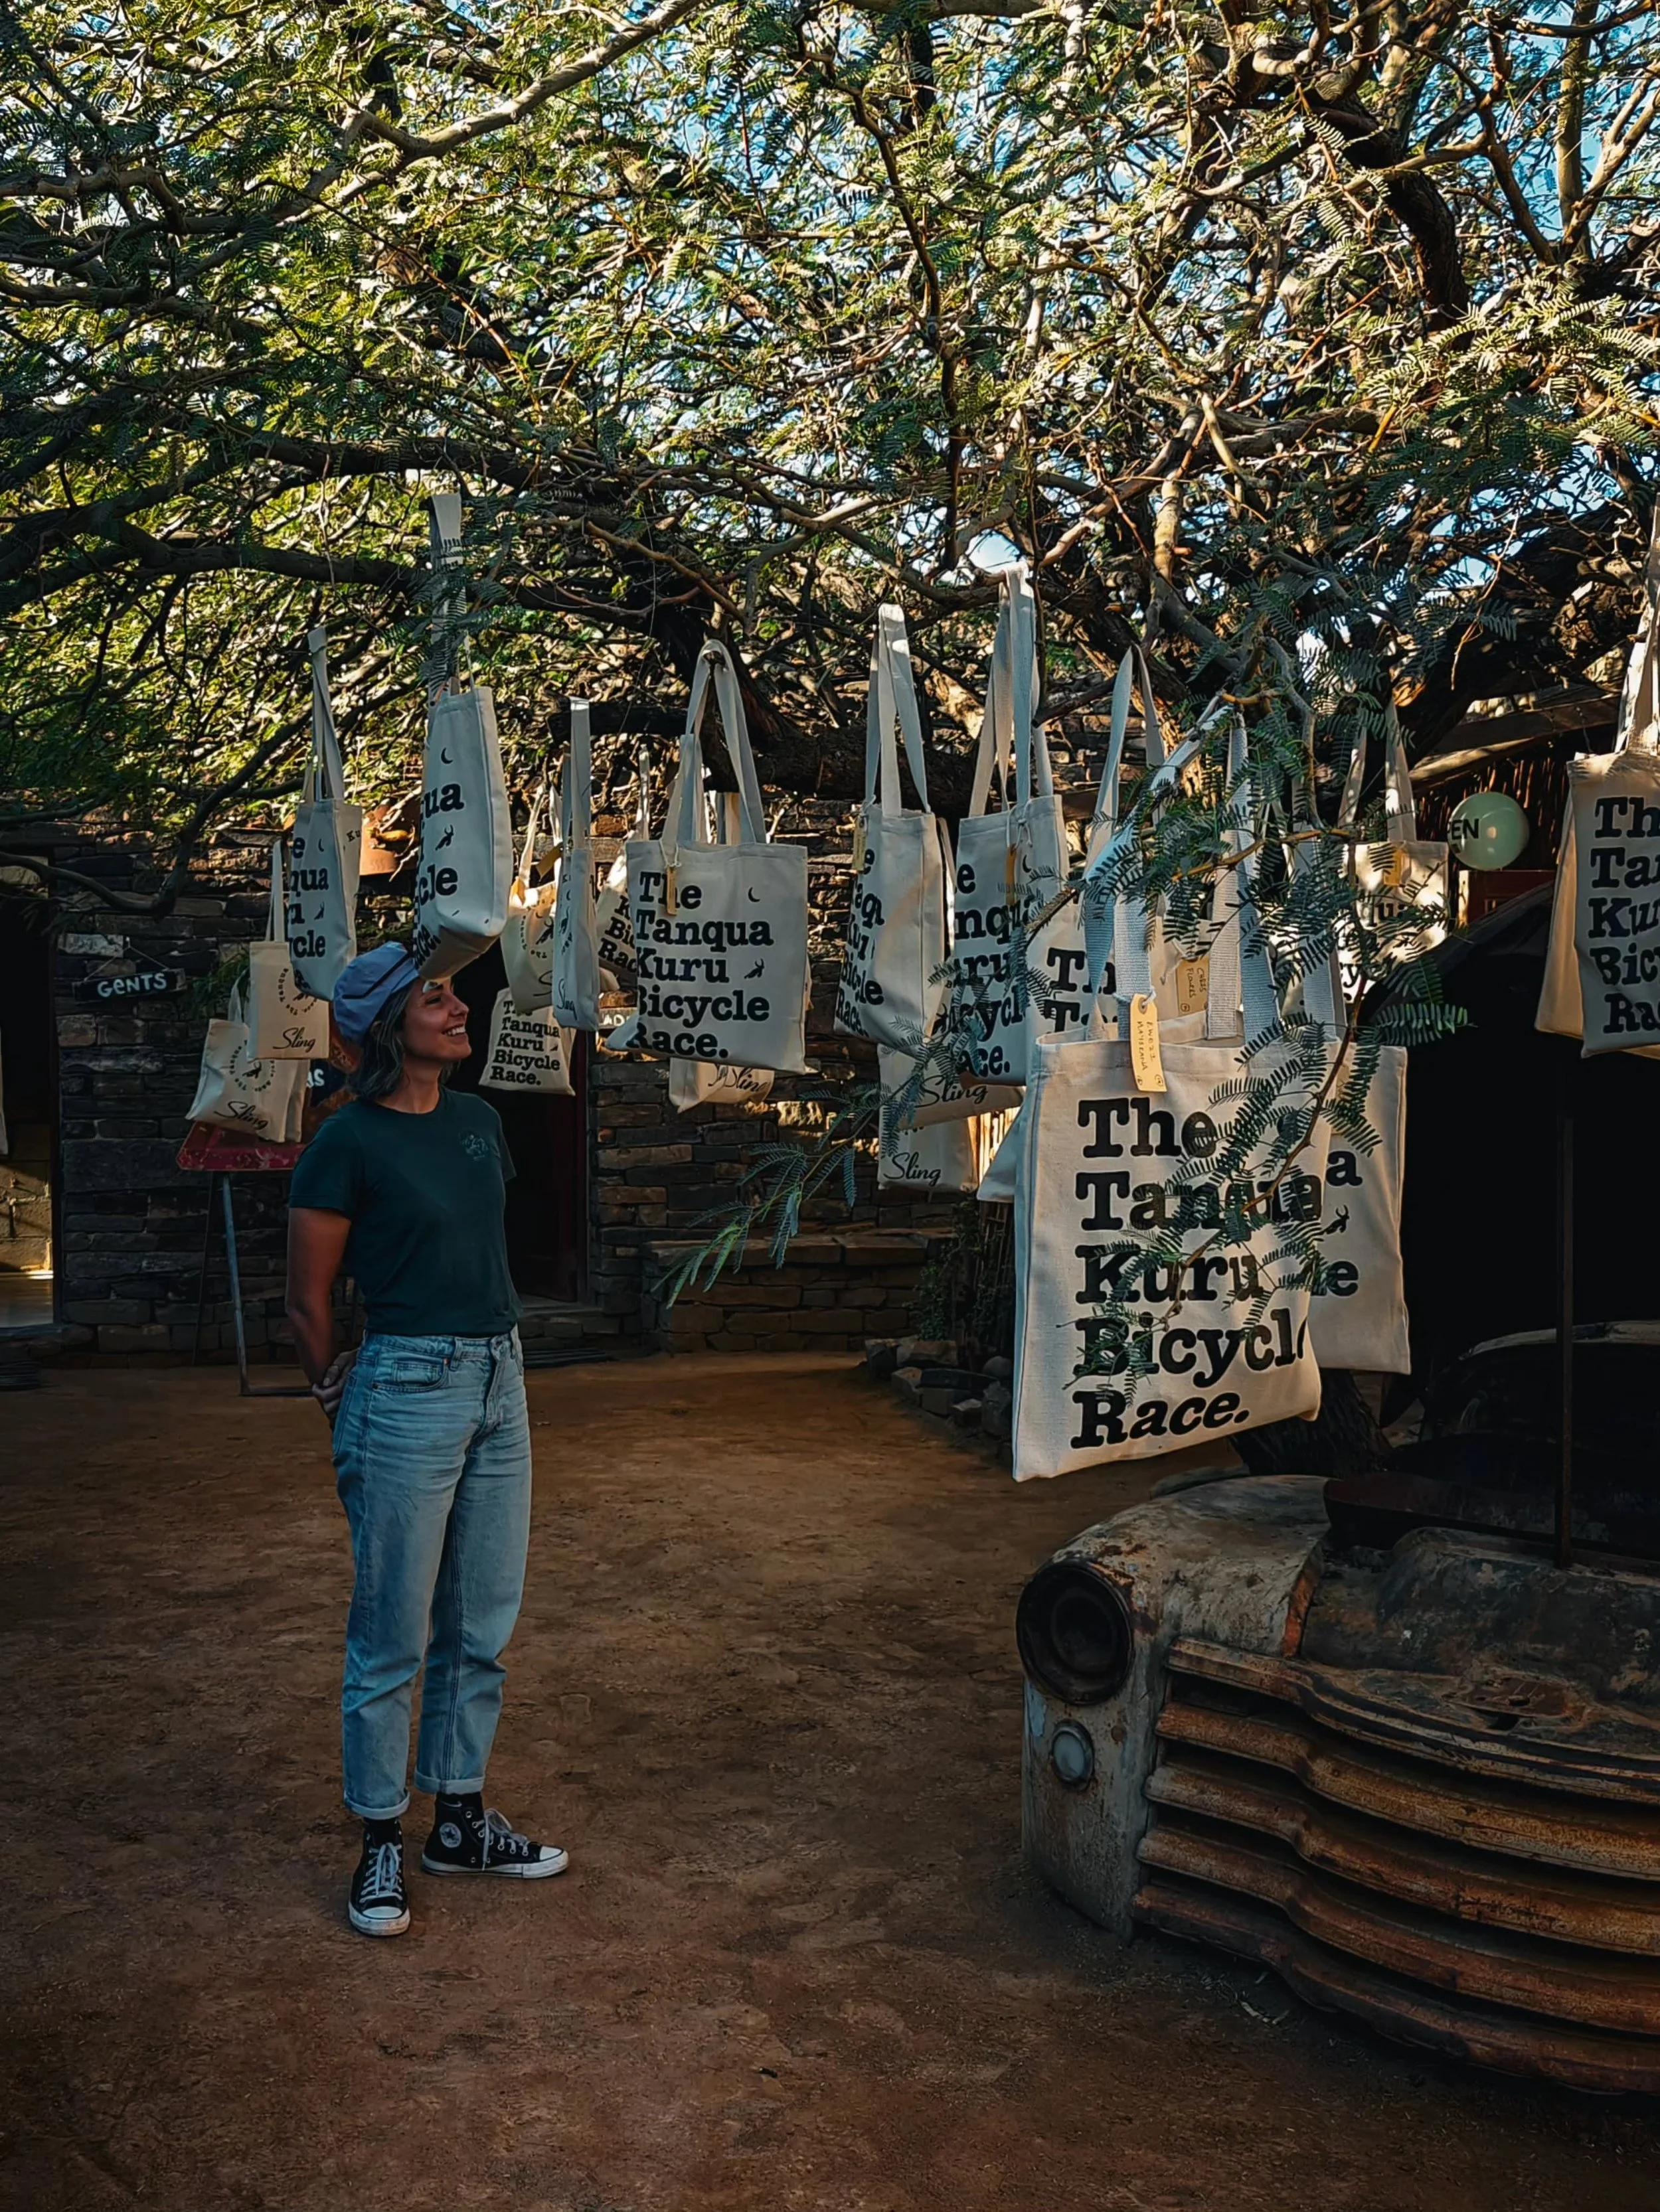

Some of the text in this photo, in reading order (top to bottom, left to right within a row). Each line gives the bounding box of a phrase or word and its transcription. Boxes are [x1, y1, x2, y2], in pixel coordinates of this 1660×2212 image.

[636, 909, 774, 953] Tanqua
[636, 947, 730, 983] Kuru
[273, 1027, 315, 1053] Sling
[501, 1016, 560, 1039] Tanqua
[497, 1033, 544, 1052] Kuru
[493, 1048, 561, 1071] Bicycle
[489, 1066, 542, 1086] Race.
[913, 1075, 988, 1104] Sling
[213, 1101, 268, 1129] Sling
[1077, 1097, 1217, 1158] The
[883, 1152, 942, 1186] Sling
[1074, 1245, 1264, 1304] Kuru
[1070, 1391, 1250, 1449] Race.
